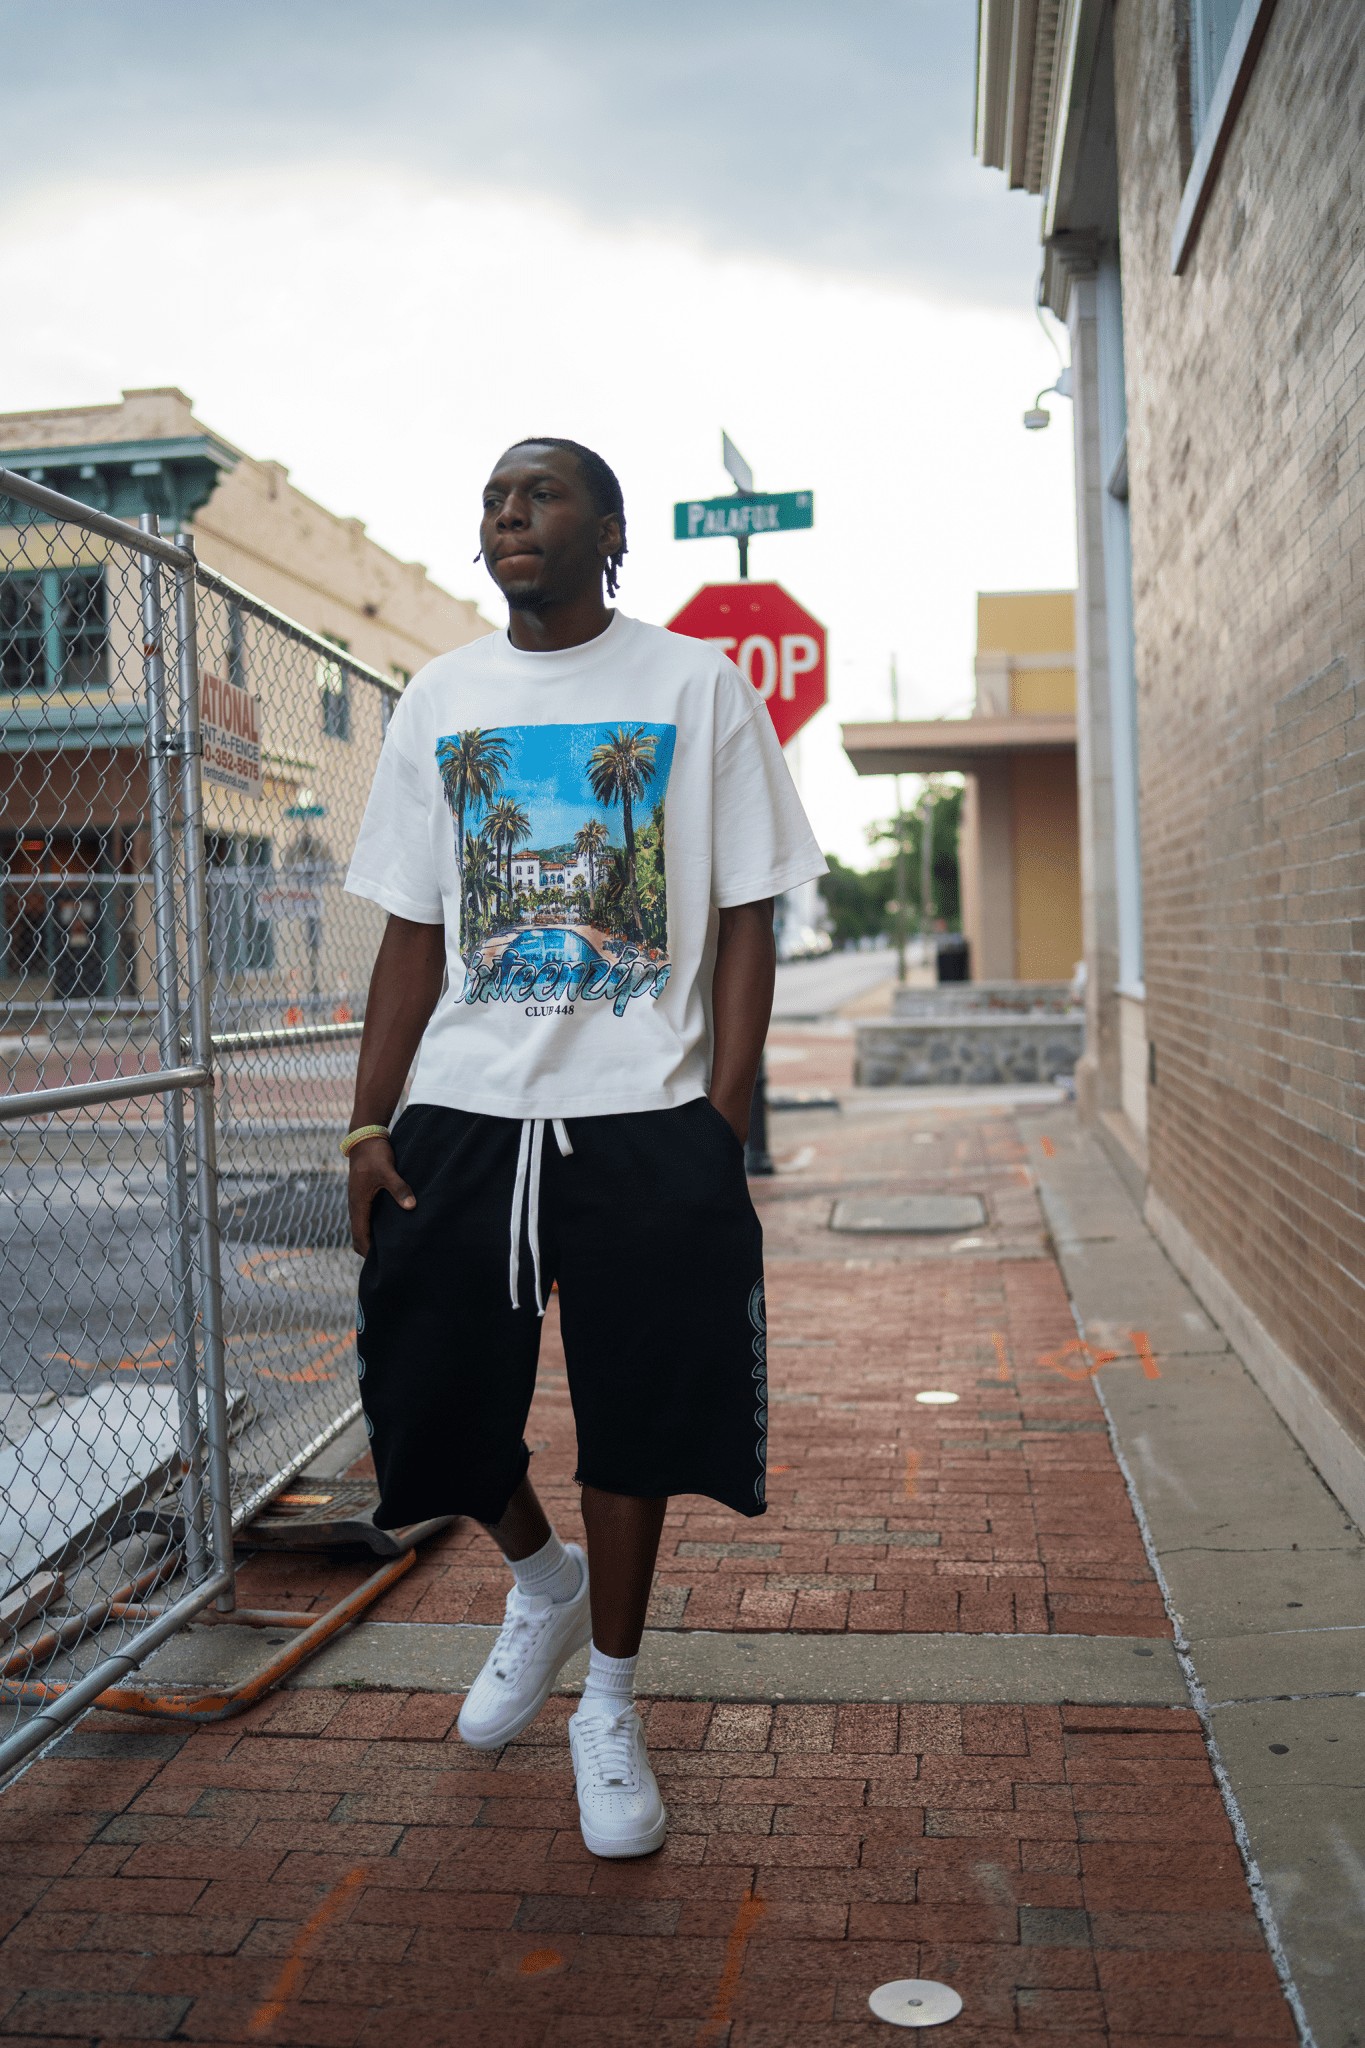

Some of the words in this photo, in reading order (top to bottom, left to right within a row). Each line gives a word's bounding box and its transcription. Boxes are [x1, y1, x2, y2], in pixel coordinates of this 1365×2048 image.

[704, 634, 820, 701] OP
[199, 670, 258, 743] ATIONAL
[200, 722, 259, 761] NT-A-FENCE
[201, 743, 259, 781] 0-352-5675
